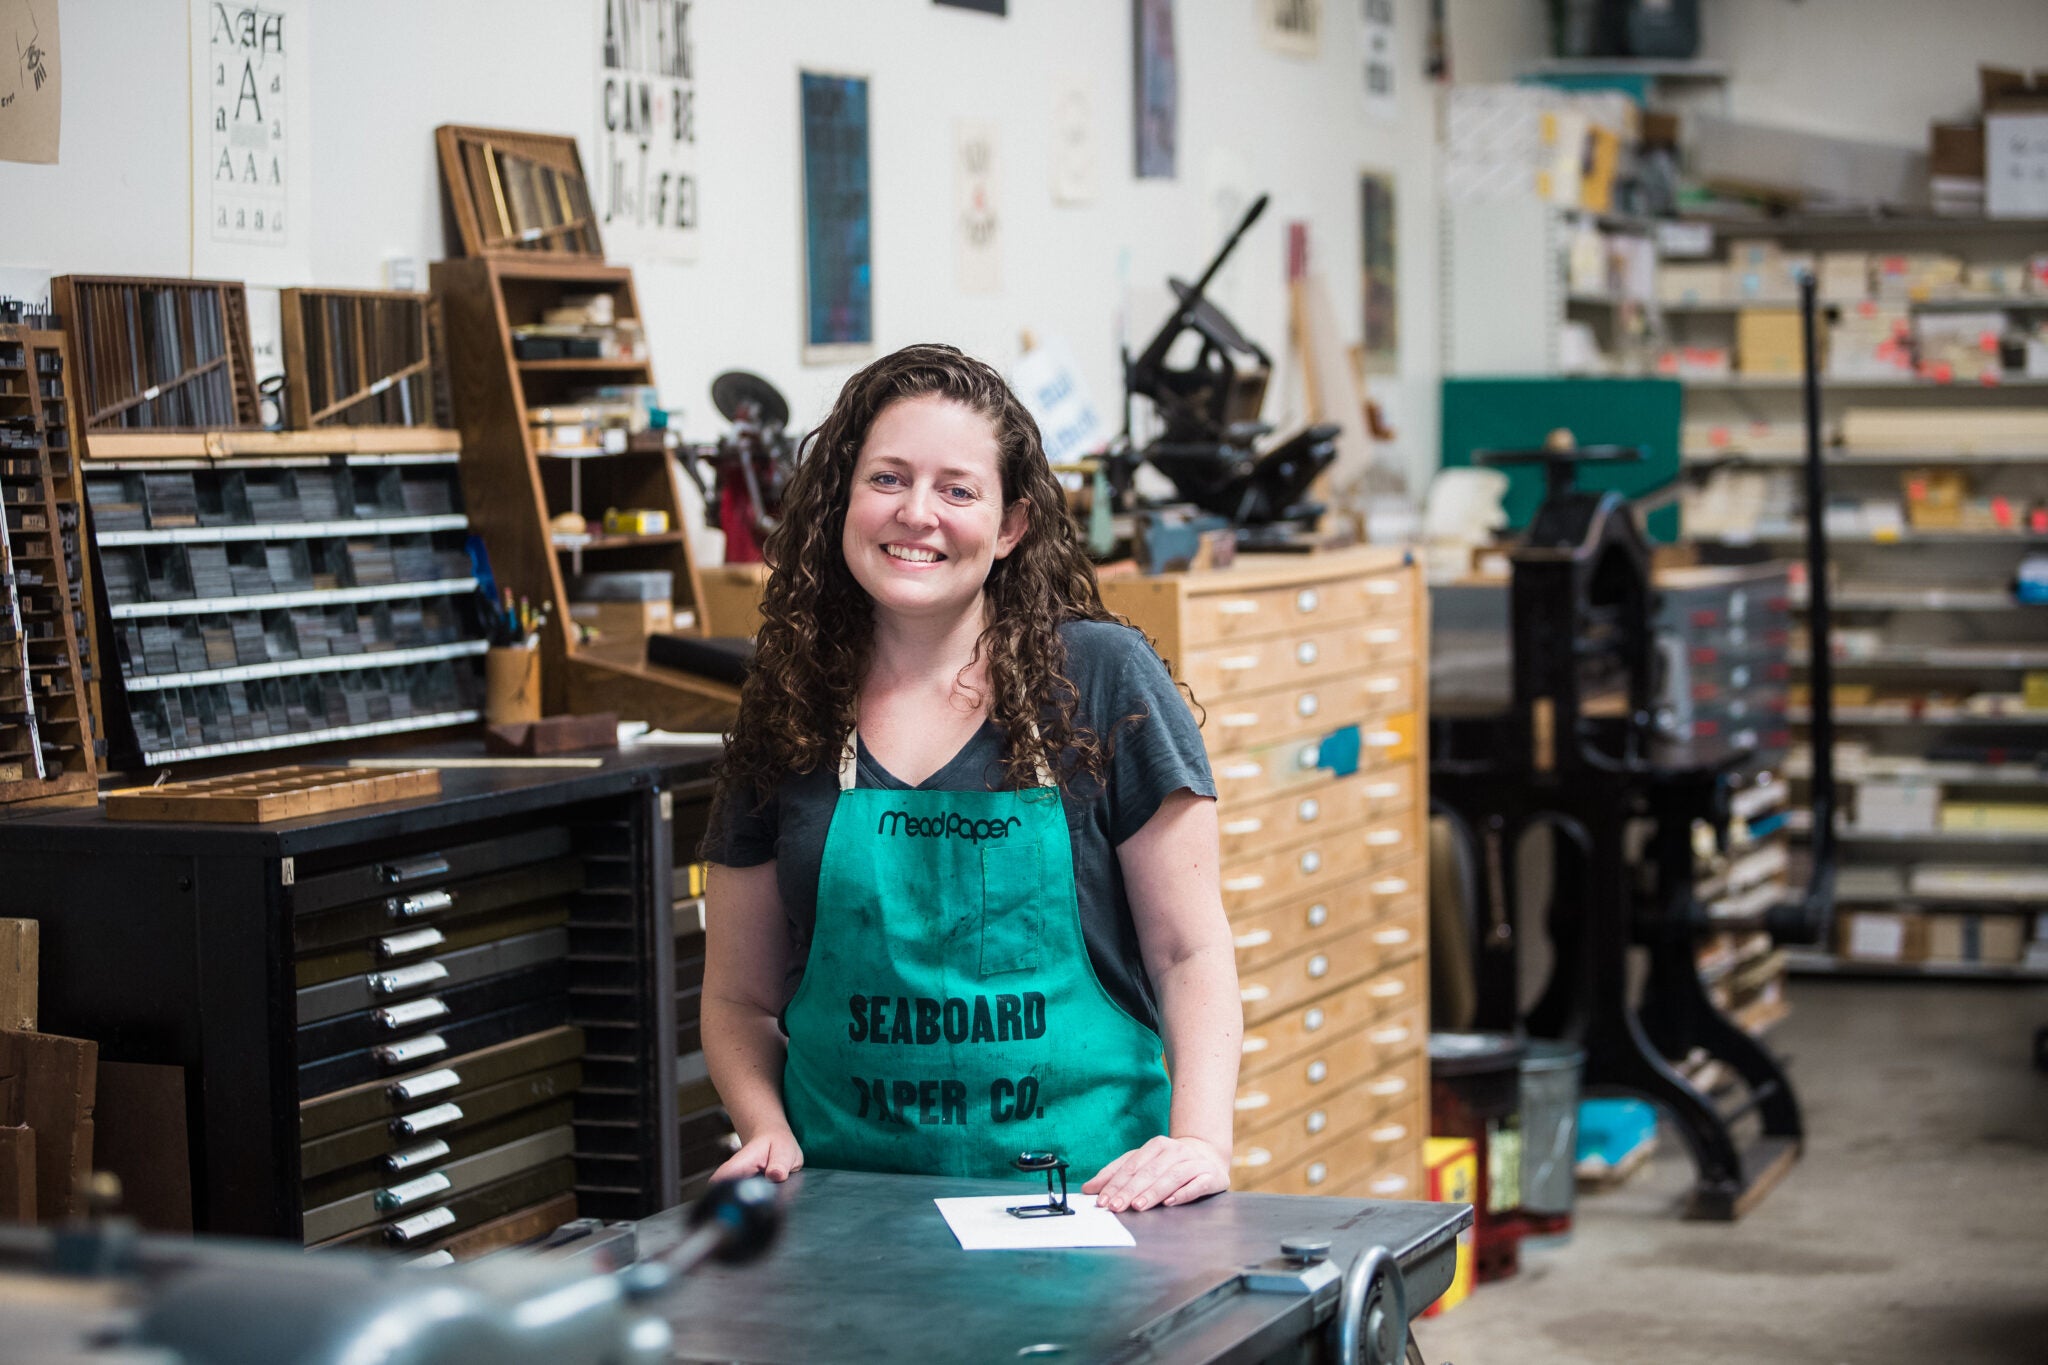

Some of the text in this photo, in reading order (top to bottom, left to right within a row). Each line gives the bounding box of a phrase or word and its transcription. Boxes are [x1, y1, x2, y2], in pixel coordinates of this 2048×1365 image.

[235, 57, 263, 122] A
[849, 991, 1047, 1045] SEABOARD
[990, 1076, 1044, 1123] CO.
